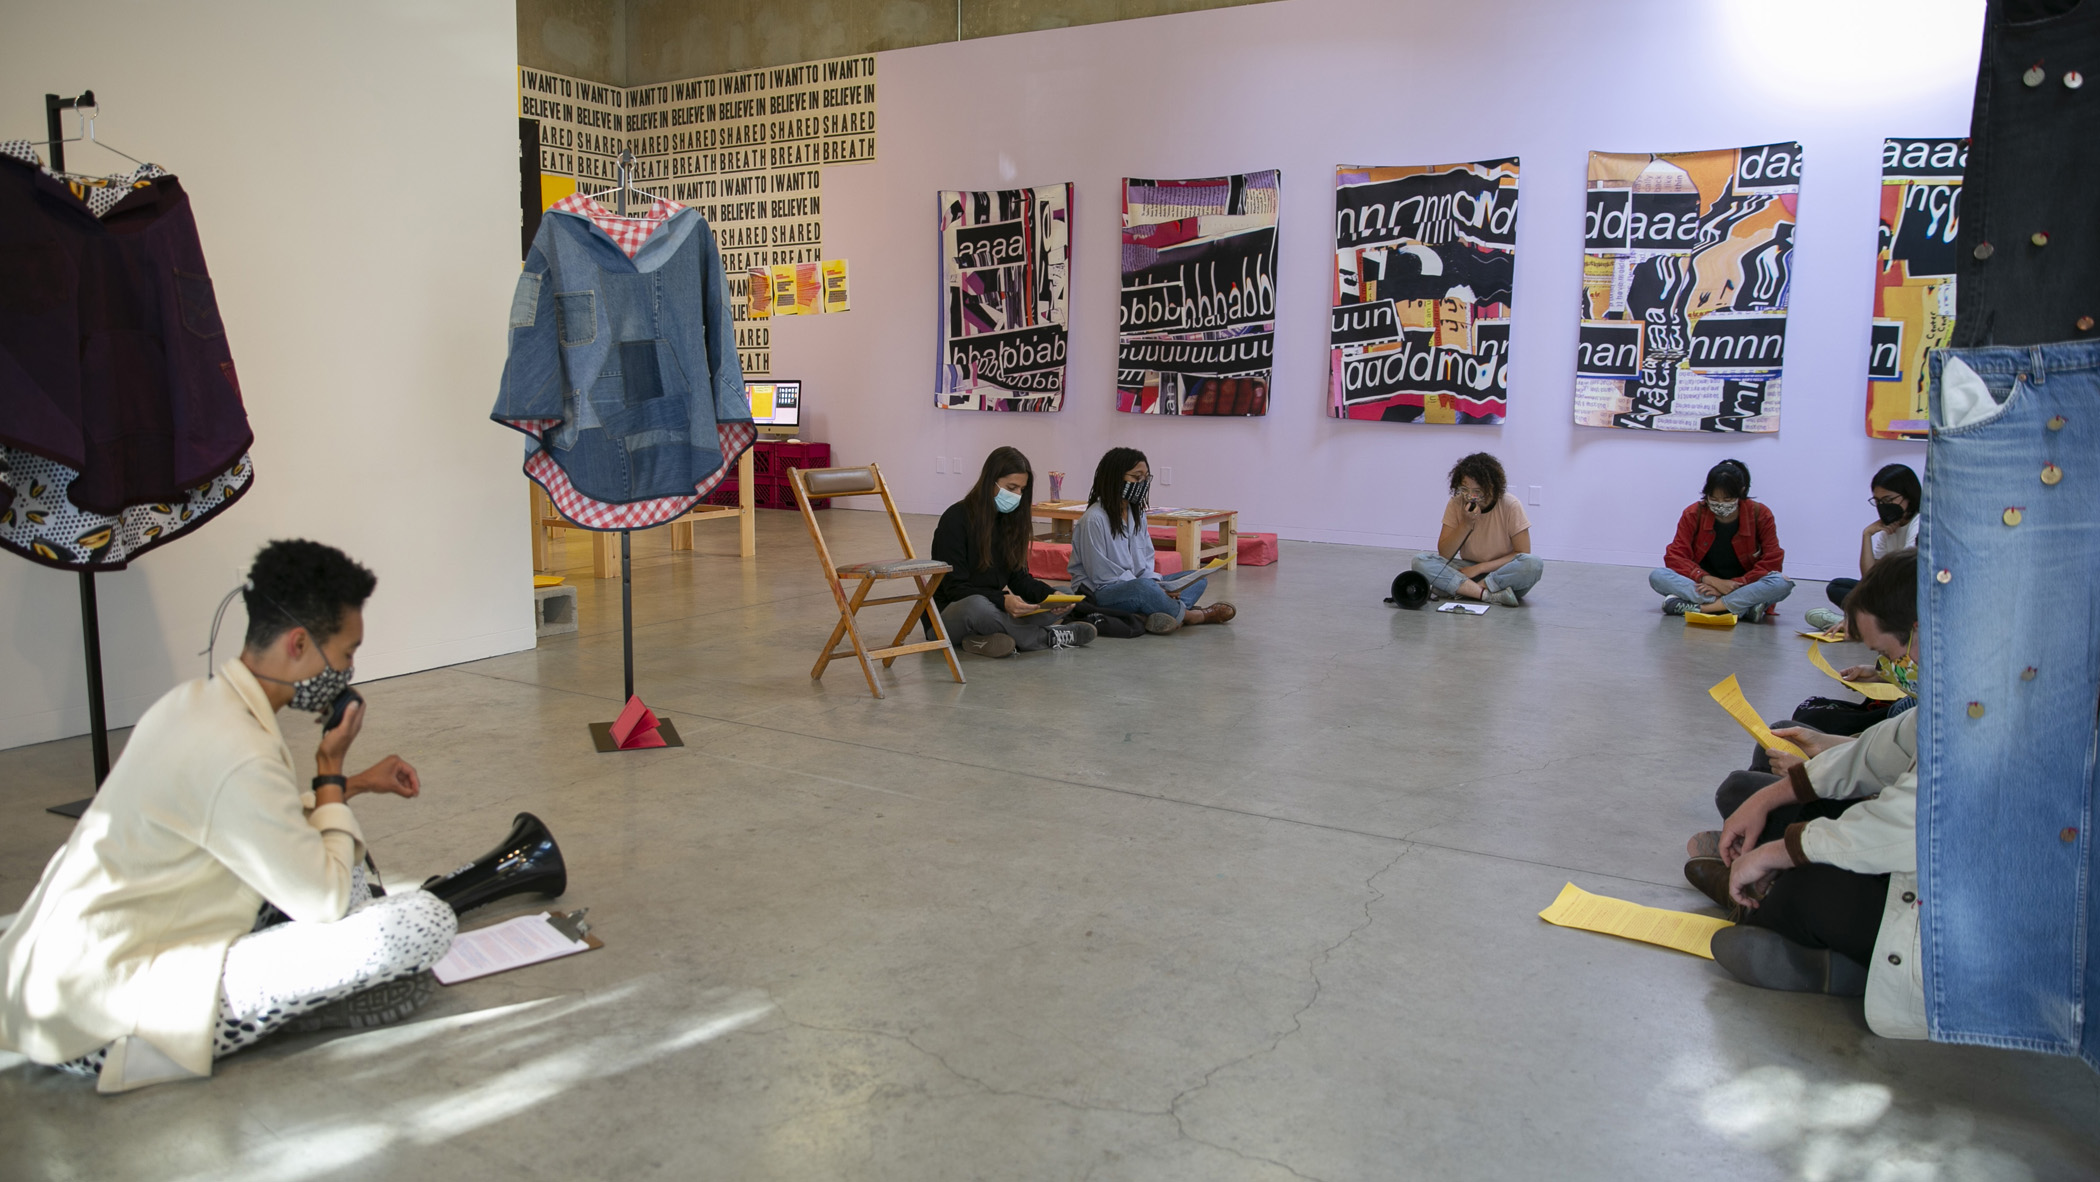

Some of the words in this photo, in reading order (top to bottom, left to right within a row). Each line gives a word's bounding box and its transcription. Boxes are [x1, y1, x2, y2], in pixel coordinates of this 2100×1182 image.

[527, 71, 557, 94] WANT
[559, 78, 571, 98] TO
[581, 83, 609, 105] WANT
[611, 90, 622, 108] TO
[630, 88, 655, 107] WANT
[657, 86, 668, 104] TO
[676, 81, 702, 101] WANT
[704, 79, 716, 97] TO
[723, 74, 752, 95] WANT
[754, 72, 766, 91] TO
[774, 67, 804, 88] WANT
[806, 64, 819, 83] TO
[828, 59, 859, 81] WANT
[861, 57, 874, 76] TO
[523, 96, 561, 120] BELIEVE
[563, 104, 573, 123] IN
[577, 106, 612, 130] BELIEVE
[613, 114, 622, 132] IN
[626, 112, 658, 132] BELIEVE
[660, 110, 668, 128] IN
[672, 105, 705, 126] BELIEVE
[706, 103, 716, 122] IN
[720, 99, 754, 120] BELIEVE
[756, 98, 766, 116] IN
[770, 92, 806, 115] BELIEVE
[809, 90, 819, 109] IN
[823, 86, 861, 108] BELIEVE
[864, 84, 875, 103] IN
[542, 125, 573, 147] ARED
[577, 131, 623, 155] SHARED
[626, 135, 669, 155] SHARED
[672, 129, 717, 151] SHARED
[720, 123, 766, 145] SHARED
[771, 117, 819, 140] SHARED
[823, 111, 875, 134] SHARED
[542, 150, 573, 173] EATH
[578, 156, 615, 178] BREAT
[673, 153, 717, 175] BREATH
[720, 149, 766, 170] BREATH
[771, 142, 820, 166] BREATH
[823, 137, 875, 160] BREATH
[631, 187, 657, 205] WANT
[677, 182, 704, 201] WANT
[705, 180, 717, 198] TO
[725, 177, 753, 196] WANT
[754, 175, 767, 194] TO
[776, 171, 805, 192] WANT
[807, 170, 820, 189] TO
[708, 205, 717, 222] IN
[721, 202, 755, 222] BELIEVE
[758, 201, 767, 219] IN
[771, 197, 808, 218] BELIEVE
[810, 196, 820, 215] IN
[721, 226, 767, 247] SHARED
[772, 222, 821, 243] SHARED
[722, 251, 768, 271] BREATH
[772, 247, 821, 266] BREATH
[728, 279, 748, 297] WAN
[734, 328, 769, 346] ARED
[739, 353, 769, 370] EATH
